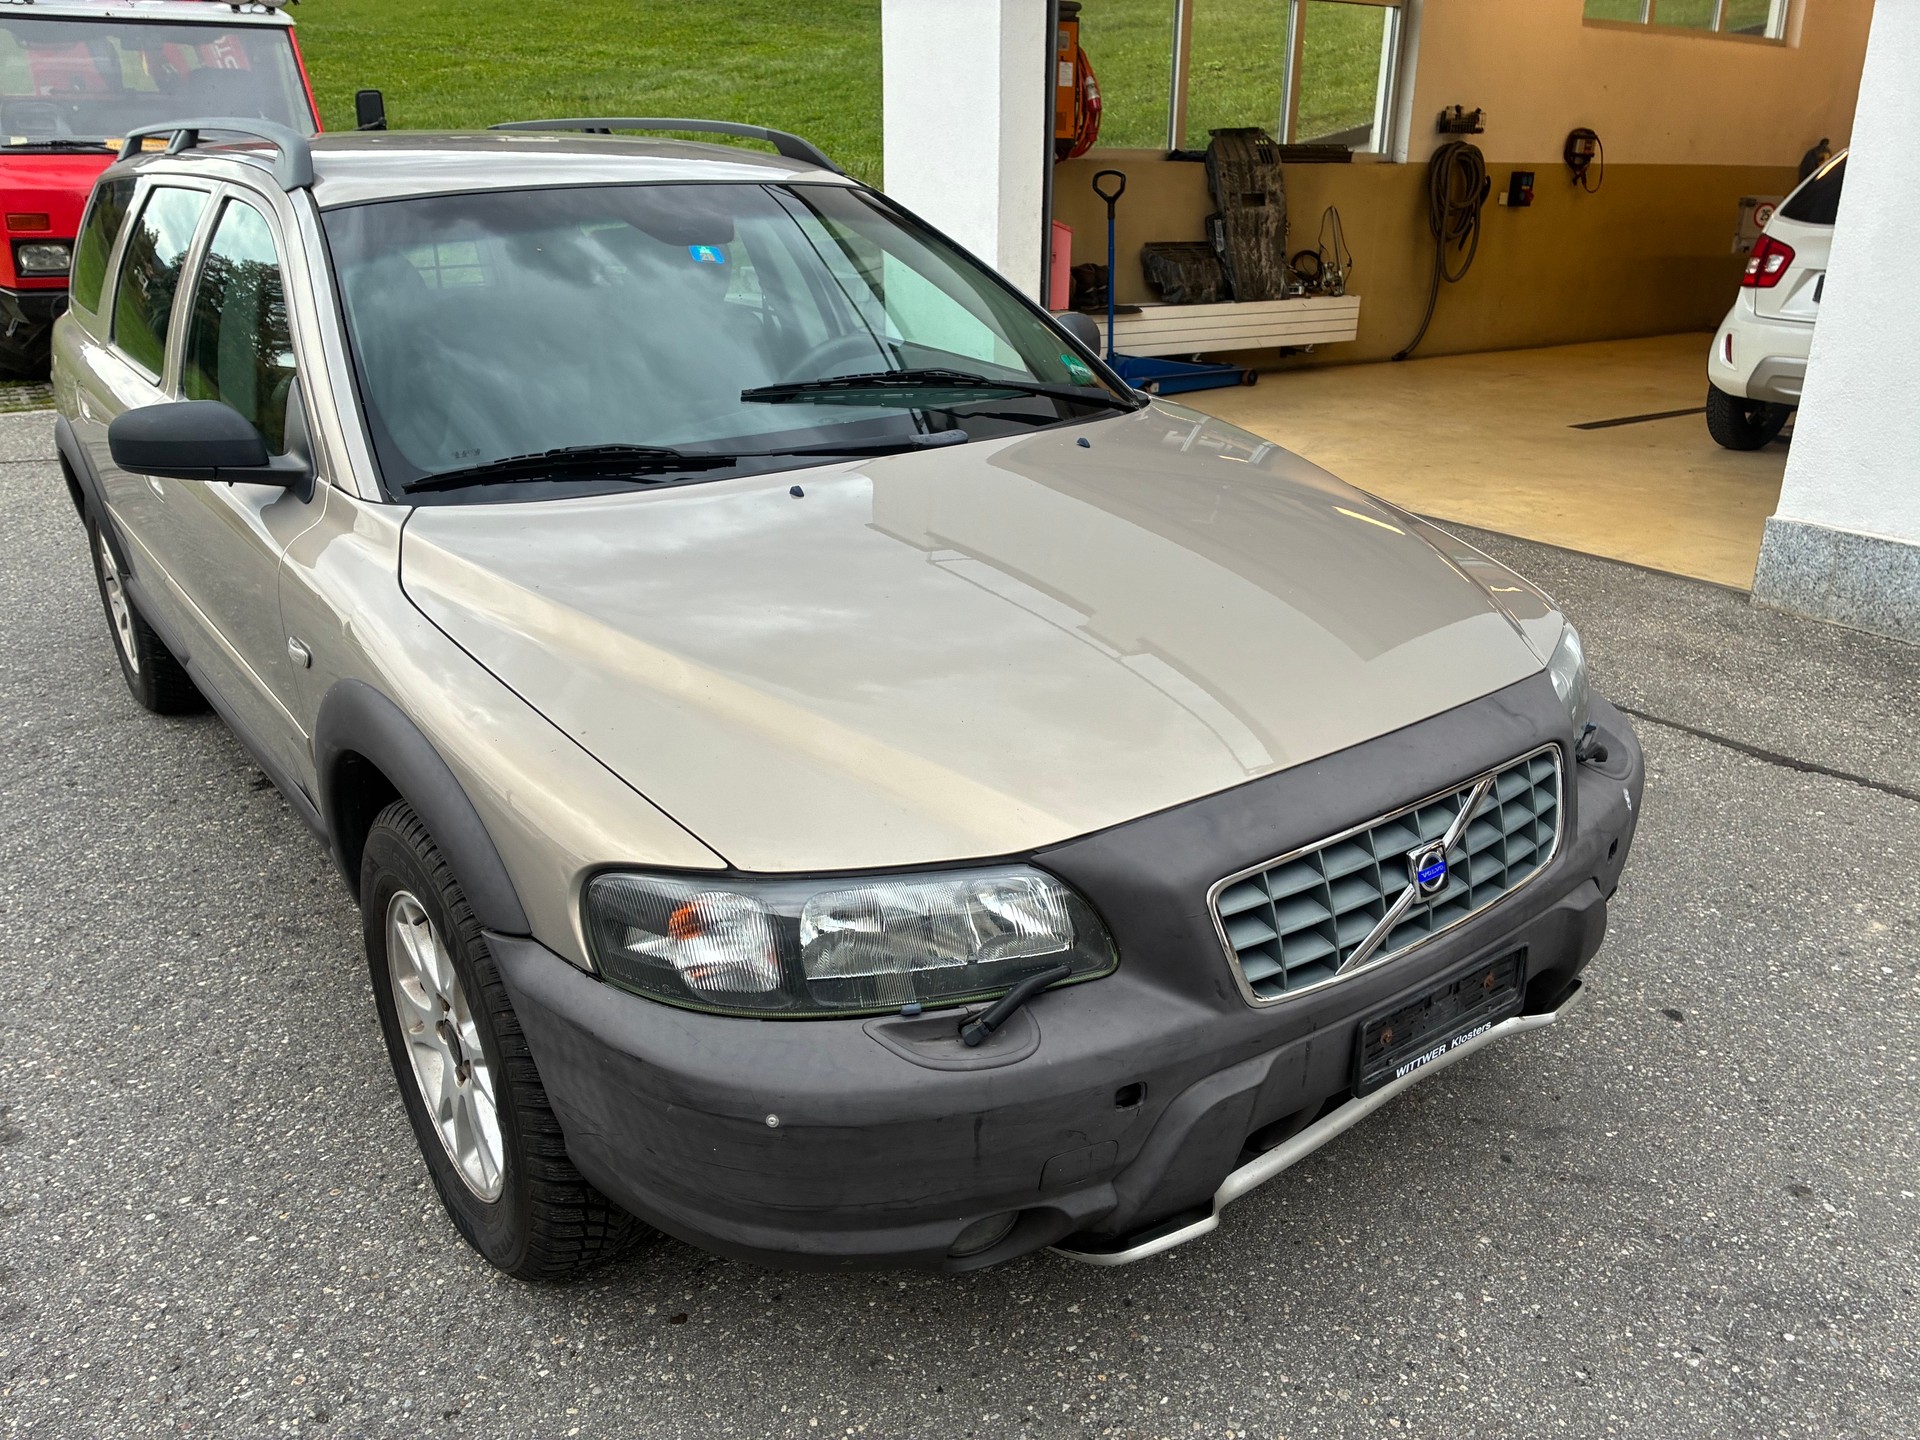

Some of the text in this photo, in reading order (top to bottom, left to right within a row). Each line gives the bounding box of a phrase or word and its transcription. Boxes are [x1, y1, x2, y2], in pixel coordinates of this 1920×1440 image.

[1421, 865, 1444, 878] VOLVO
[1396, 1021, 1492, 1078] WITTWER Klosters
